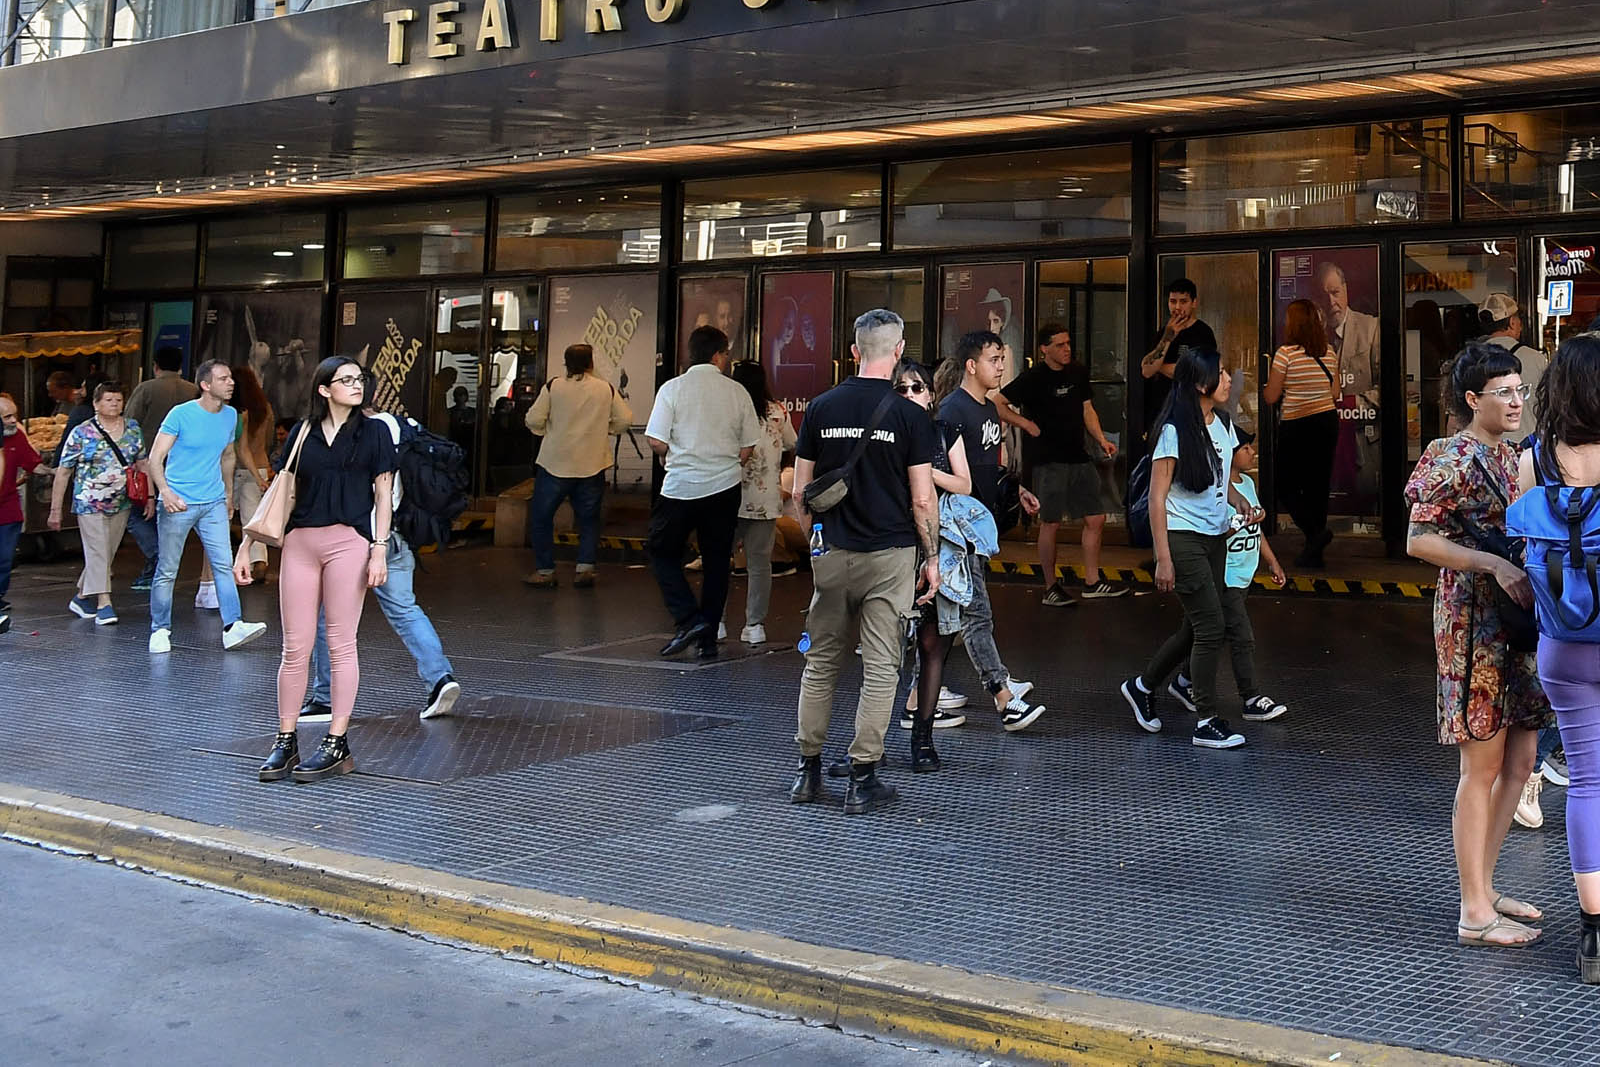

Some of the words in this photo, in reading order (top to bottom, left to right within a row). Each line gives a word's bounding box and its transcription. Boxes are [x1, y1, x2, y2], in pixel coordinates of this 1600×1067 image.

[371, 336, 396, 377] TEM
[385, 348, 402, 380] PO
[392, 337, 423, 393] RADA
